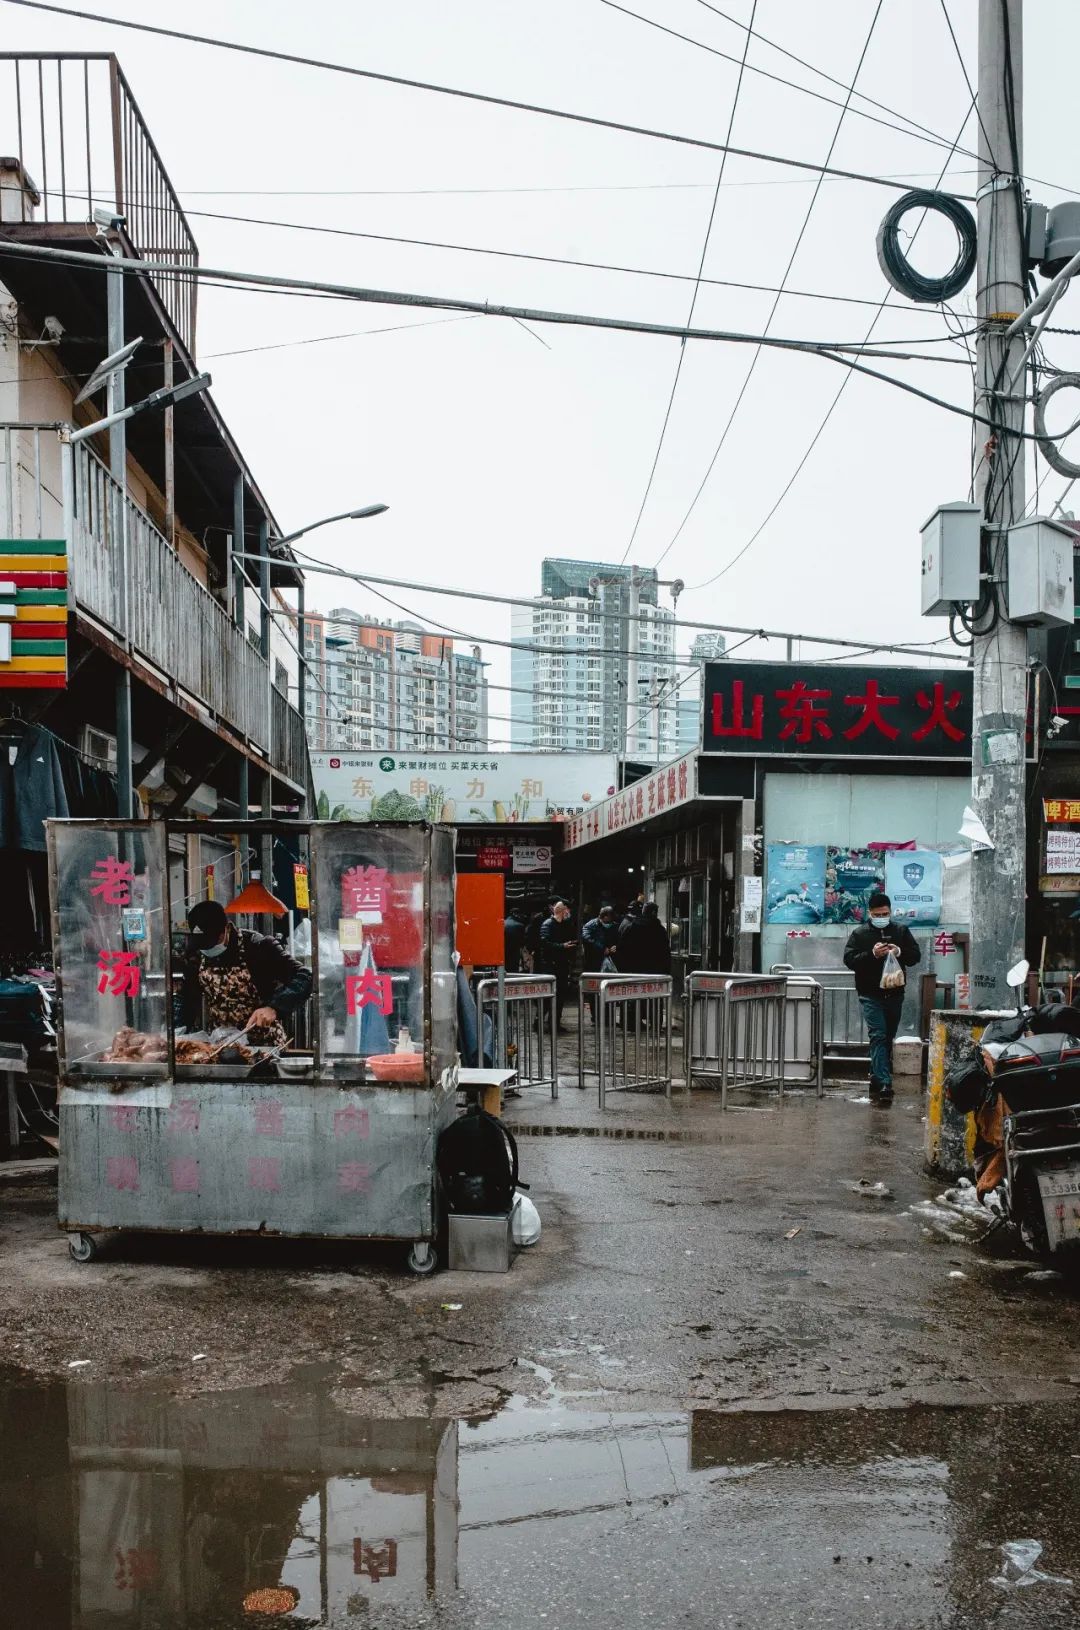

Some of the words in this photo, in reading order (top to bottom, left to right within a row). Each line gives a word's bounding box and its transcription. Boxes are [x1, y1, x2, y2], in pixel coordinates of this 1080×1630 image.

[711, 679, 1030, 743] 山东大火
[450, 761, 499, 771] 买菜天天省
[546, 806, 588, 816] 商贸有限
[1046, 800, 1080, 820] 啤酒
[934, 931, 956, 957] 车
